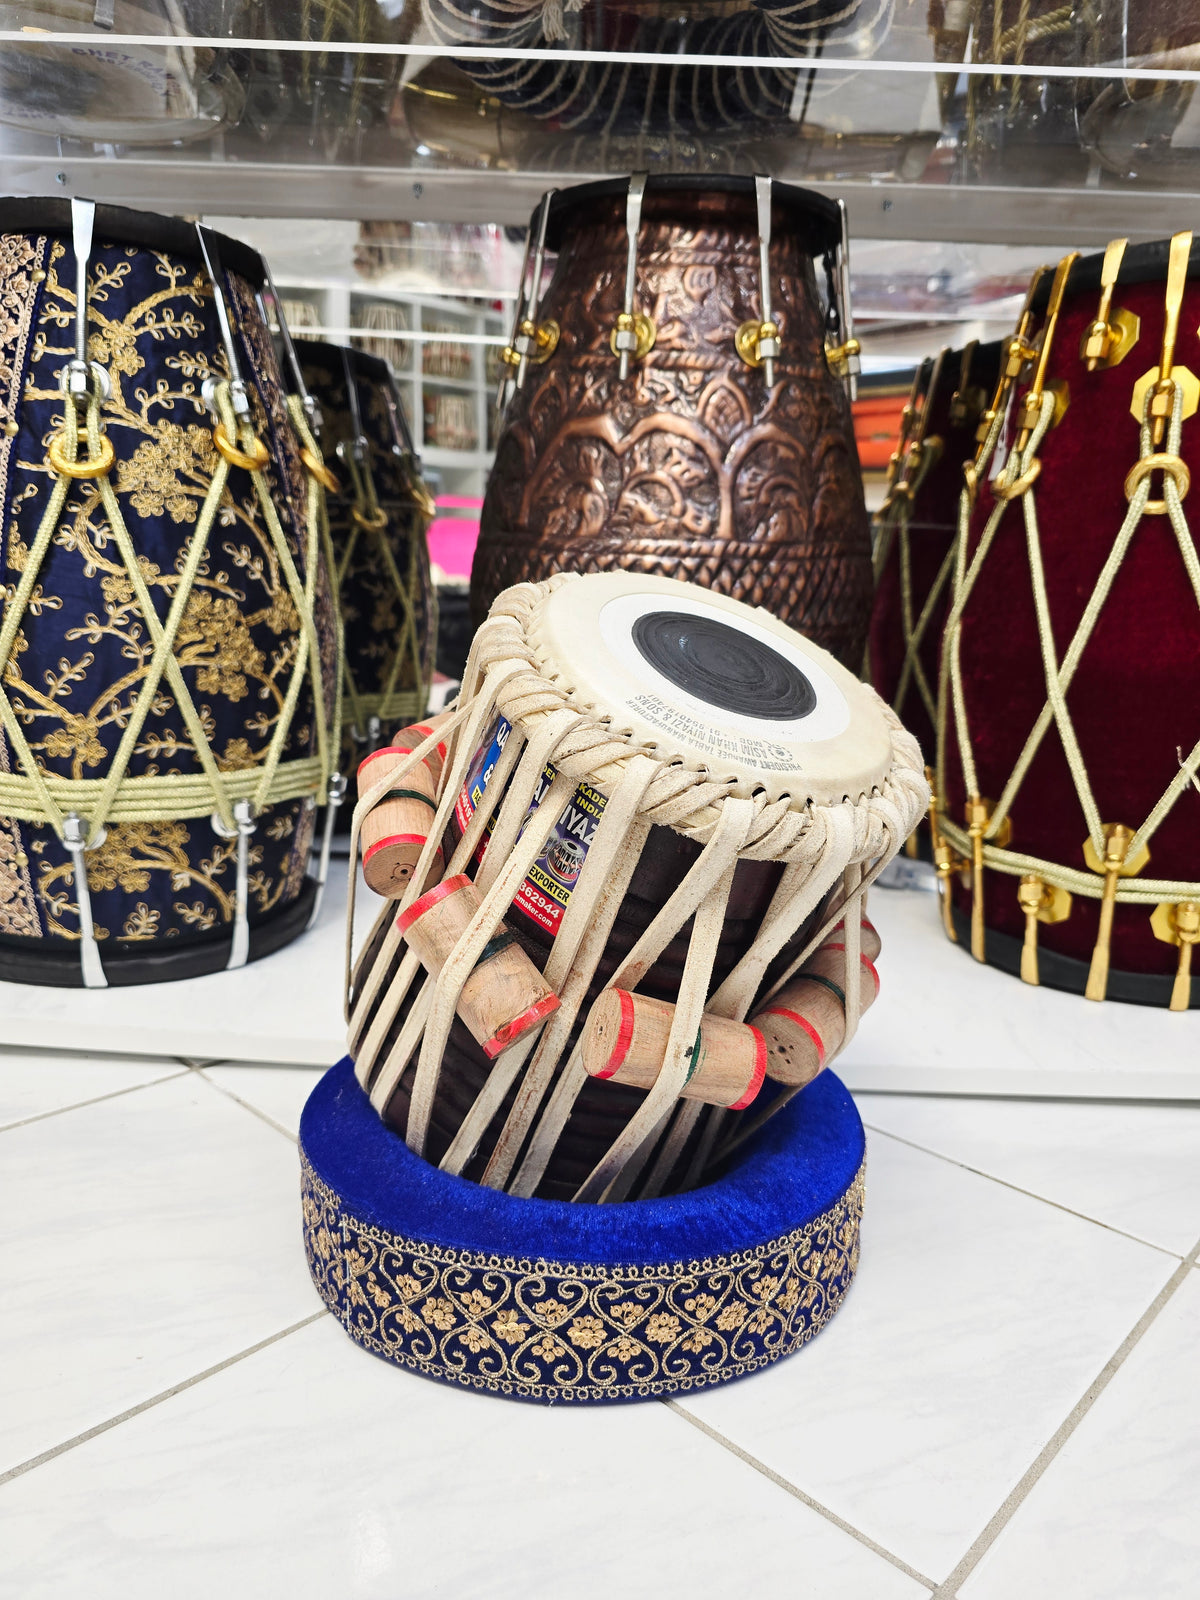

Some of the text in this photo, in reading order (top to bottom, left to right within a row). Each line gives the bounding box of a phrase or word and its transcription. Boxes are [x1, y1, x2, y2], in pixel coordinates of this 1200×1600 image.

[626, 699, 687, 742] MANUFACTURER
[635, 694, 768, 759] ASIM KHAN NIYAZI & SONS
[688, 737, 714, 755] TABLA
[760, 759, 803, 772] PRESIDENT
[576, 796, 604, 819] INDIA
[519, 881, 560, 919] 362944
[529, 866, 570, 903] EXPORTER
[515, 894, 553, 928] amaker.com
